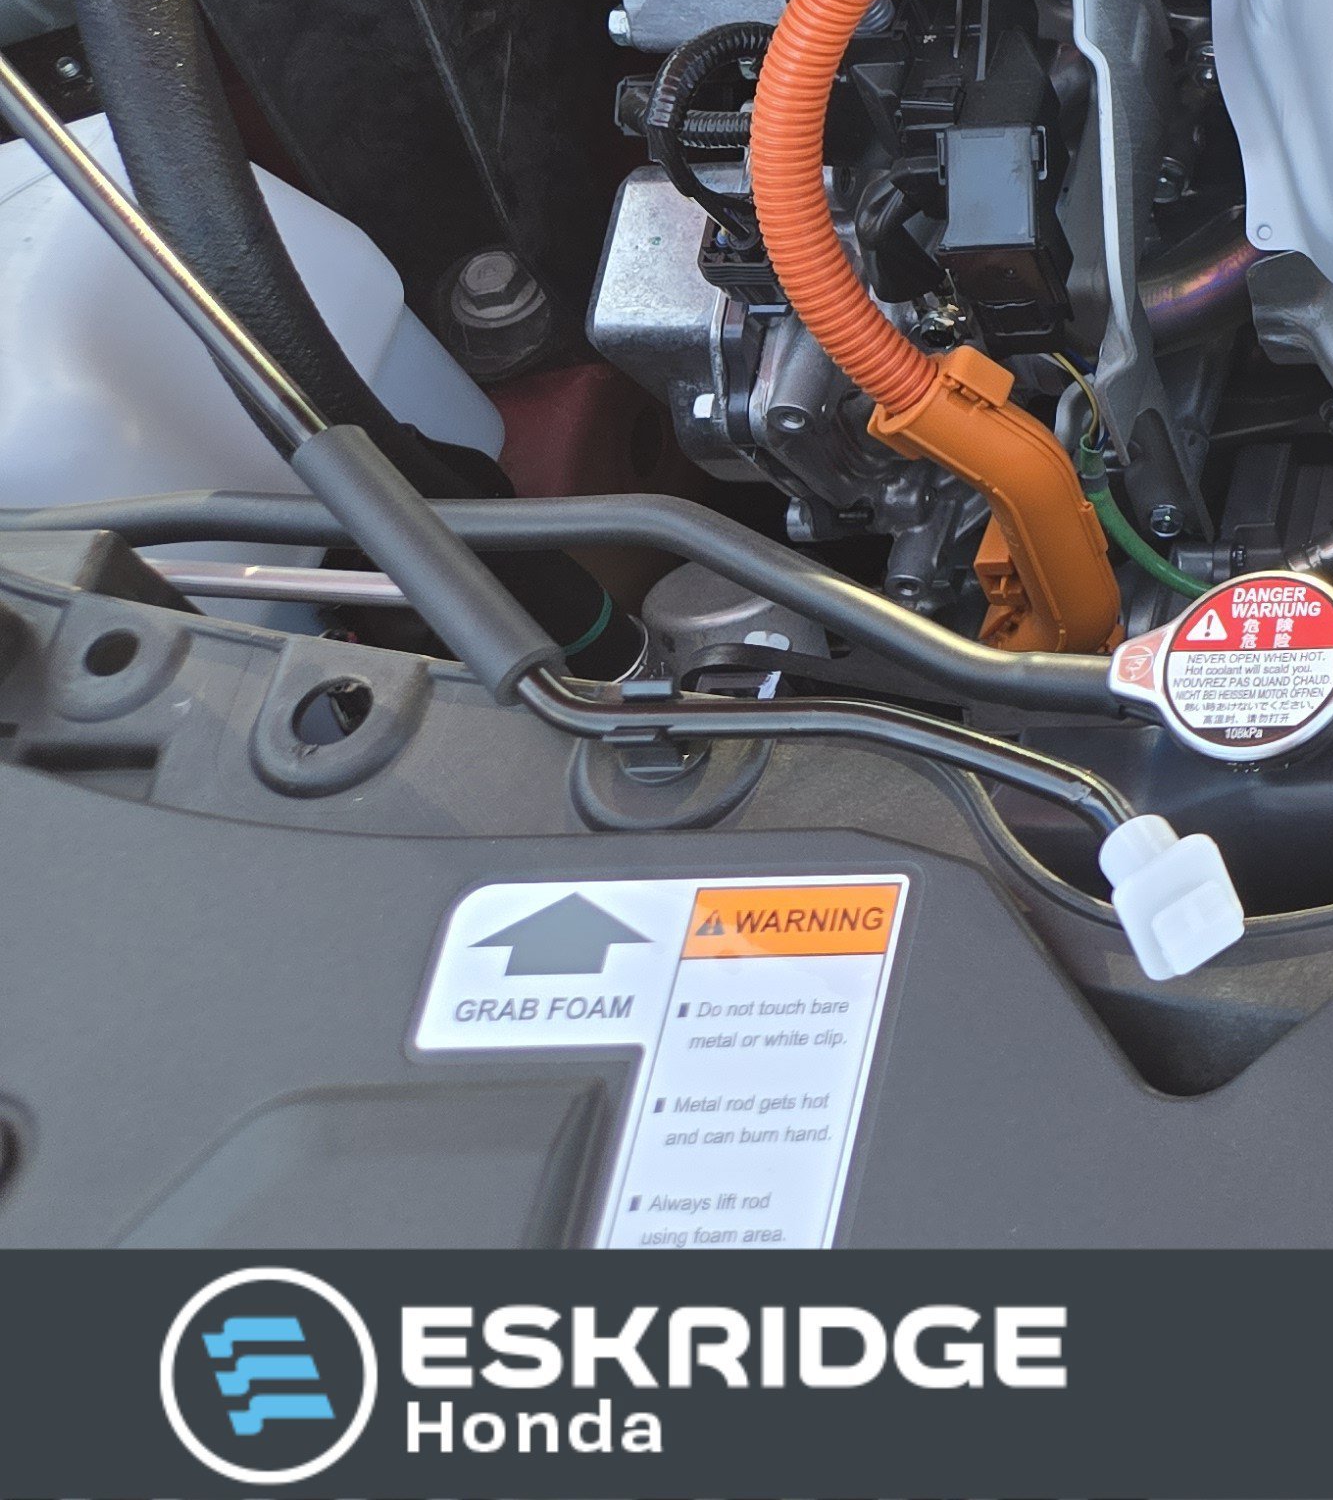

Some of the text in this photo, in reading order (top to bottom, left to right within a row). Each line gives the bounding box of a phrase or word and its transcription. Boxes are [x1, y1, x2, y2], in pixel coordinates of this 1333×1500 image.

[1233, 586, 1307, 603] DANGER
[1231, 601, 1322, 619] WARNUNG
[1187, 651, 1327, 664] NEVER OPEN WHEN HOT.
[1185, 663, 1313, 676] Hot coolant will scald you.
[1173, 676, 1227, 688] N'OUVREZ
[1229, 676, 1250, 687] PAS
[1252, 676, 1292, 687] QUAND
[1175, 689, 1201, 701] NICHT
[1202, 689, 1216, 700] BEI
[1217, 688, 1257, 700] HEISSEM
[1258, 688, 1289, 699] MOTOR
[734, 906, 885, 935] WARNING
[454, 995, 636, 1023] GRAB FOAM
[697, 998, 850, 1019] Do not touch bare
[687, 1029, 849, 1049] metal or white clip.
[673, 1093, 830, 1116] Metal rod gets hot
[664, 1125, 833, 1146] and can burn hand.
[647, 1192, 772, 1215] Always lift rod
[640, 1227, 786, 1249] using foam area.
